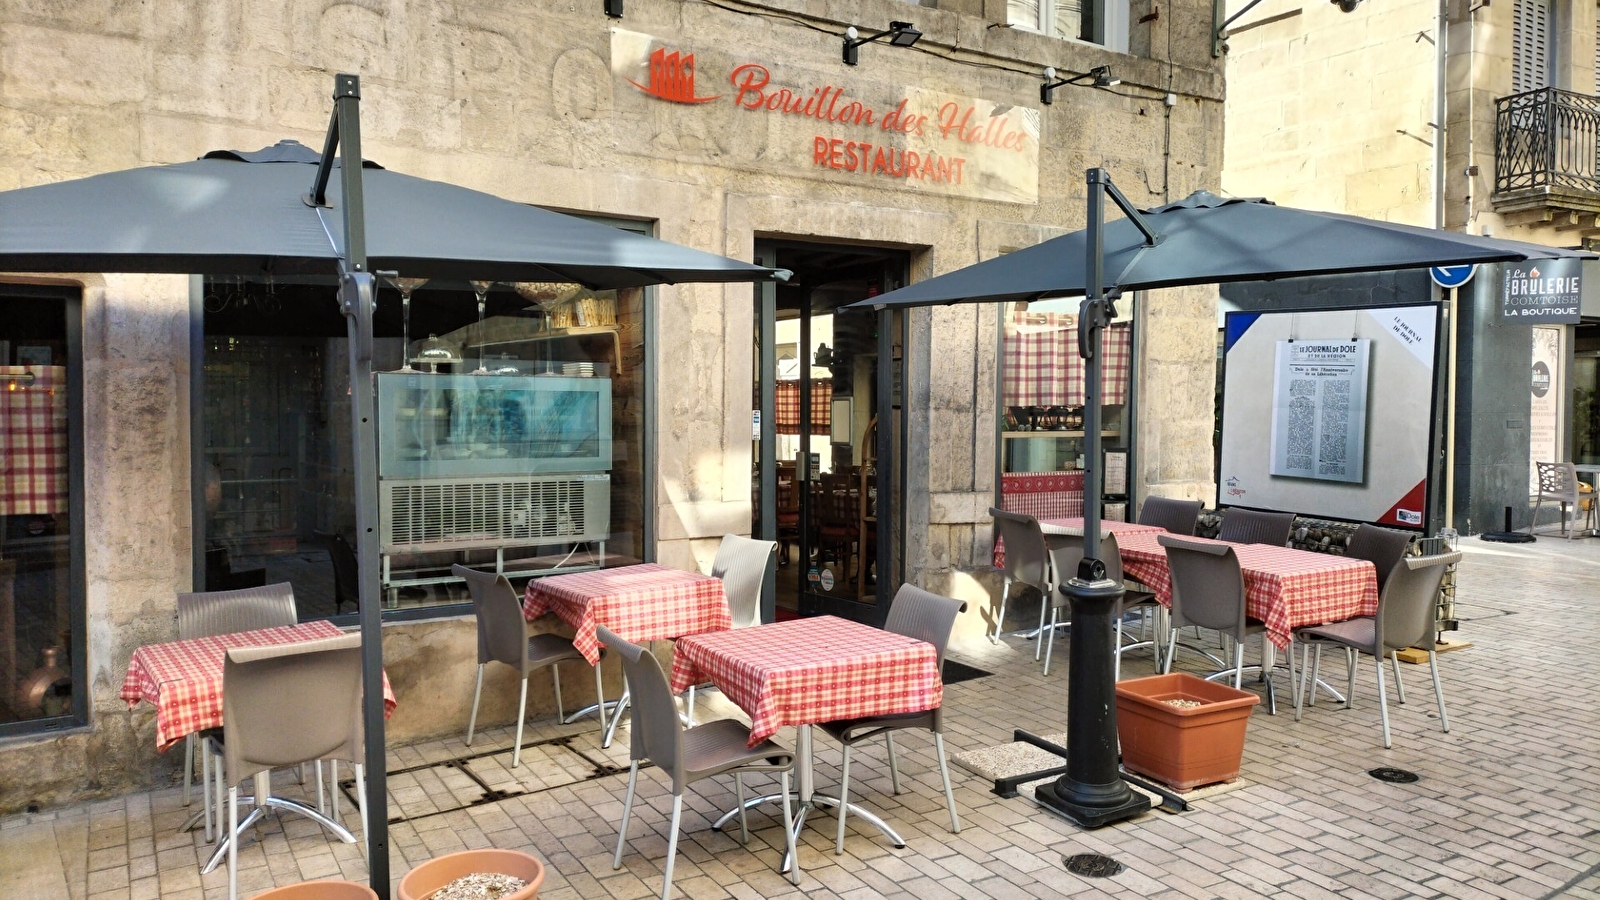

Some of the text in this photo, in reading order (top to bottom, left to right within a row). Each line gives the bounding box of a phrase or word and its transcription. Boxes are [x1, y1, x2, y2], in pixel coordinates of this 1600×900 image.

[730, 64, 1027, 153] Bouillon des Halles
[814, 136, 966, 185] RESTAURANT
[1512, 269, 1526, 279] La
[1511, 295, 1579, 306] COMTOISE
[1504, 307, 1578, 317] LA BOUTIQUE
[1339, 345, 1357, 353] DOLE
